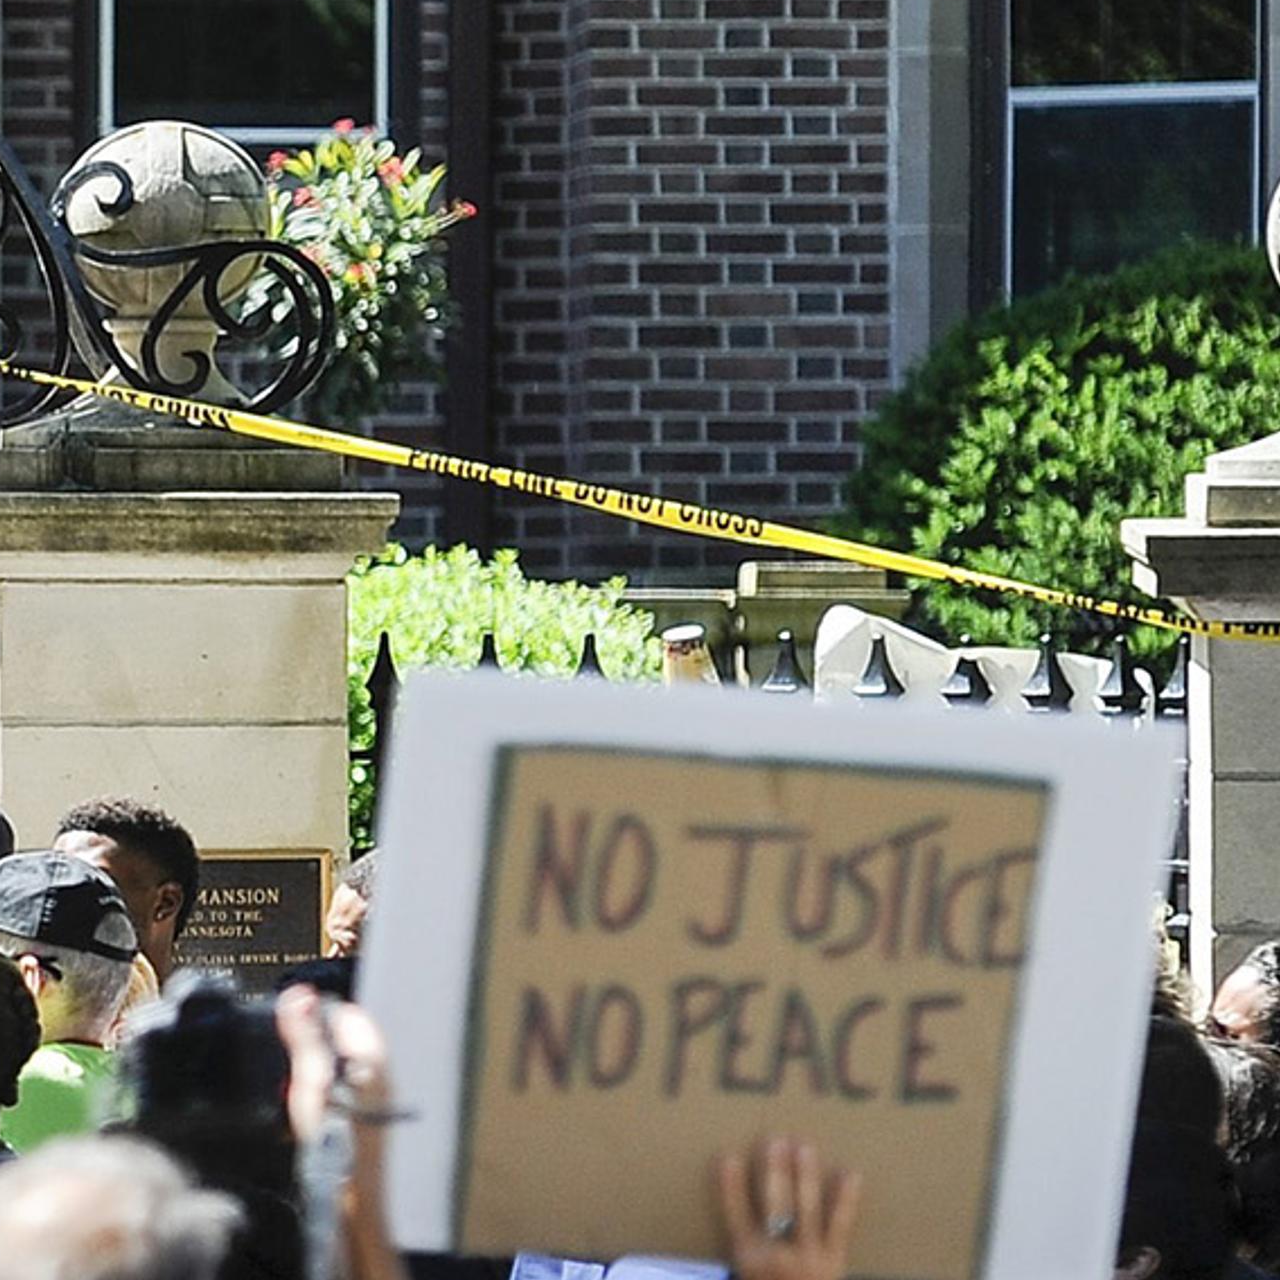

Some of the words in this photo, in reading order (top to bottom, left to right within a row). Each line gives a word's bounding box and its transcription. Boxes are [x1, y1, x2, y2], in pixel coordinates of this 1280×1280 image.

[178, 926, 254, 938] INNESOTA
[525, 801, 657, 933] NO
[683, 814, 1041, 970] JUSTICE
[508, 980, 647, 1096] NO
[660, 973, 968, 1105] PEACE
